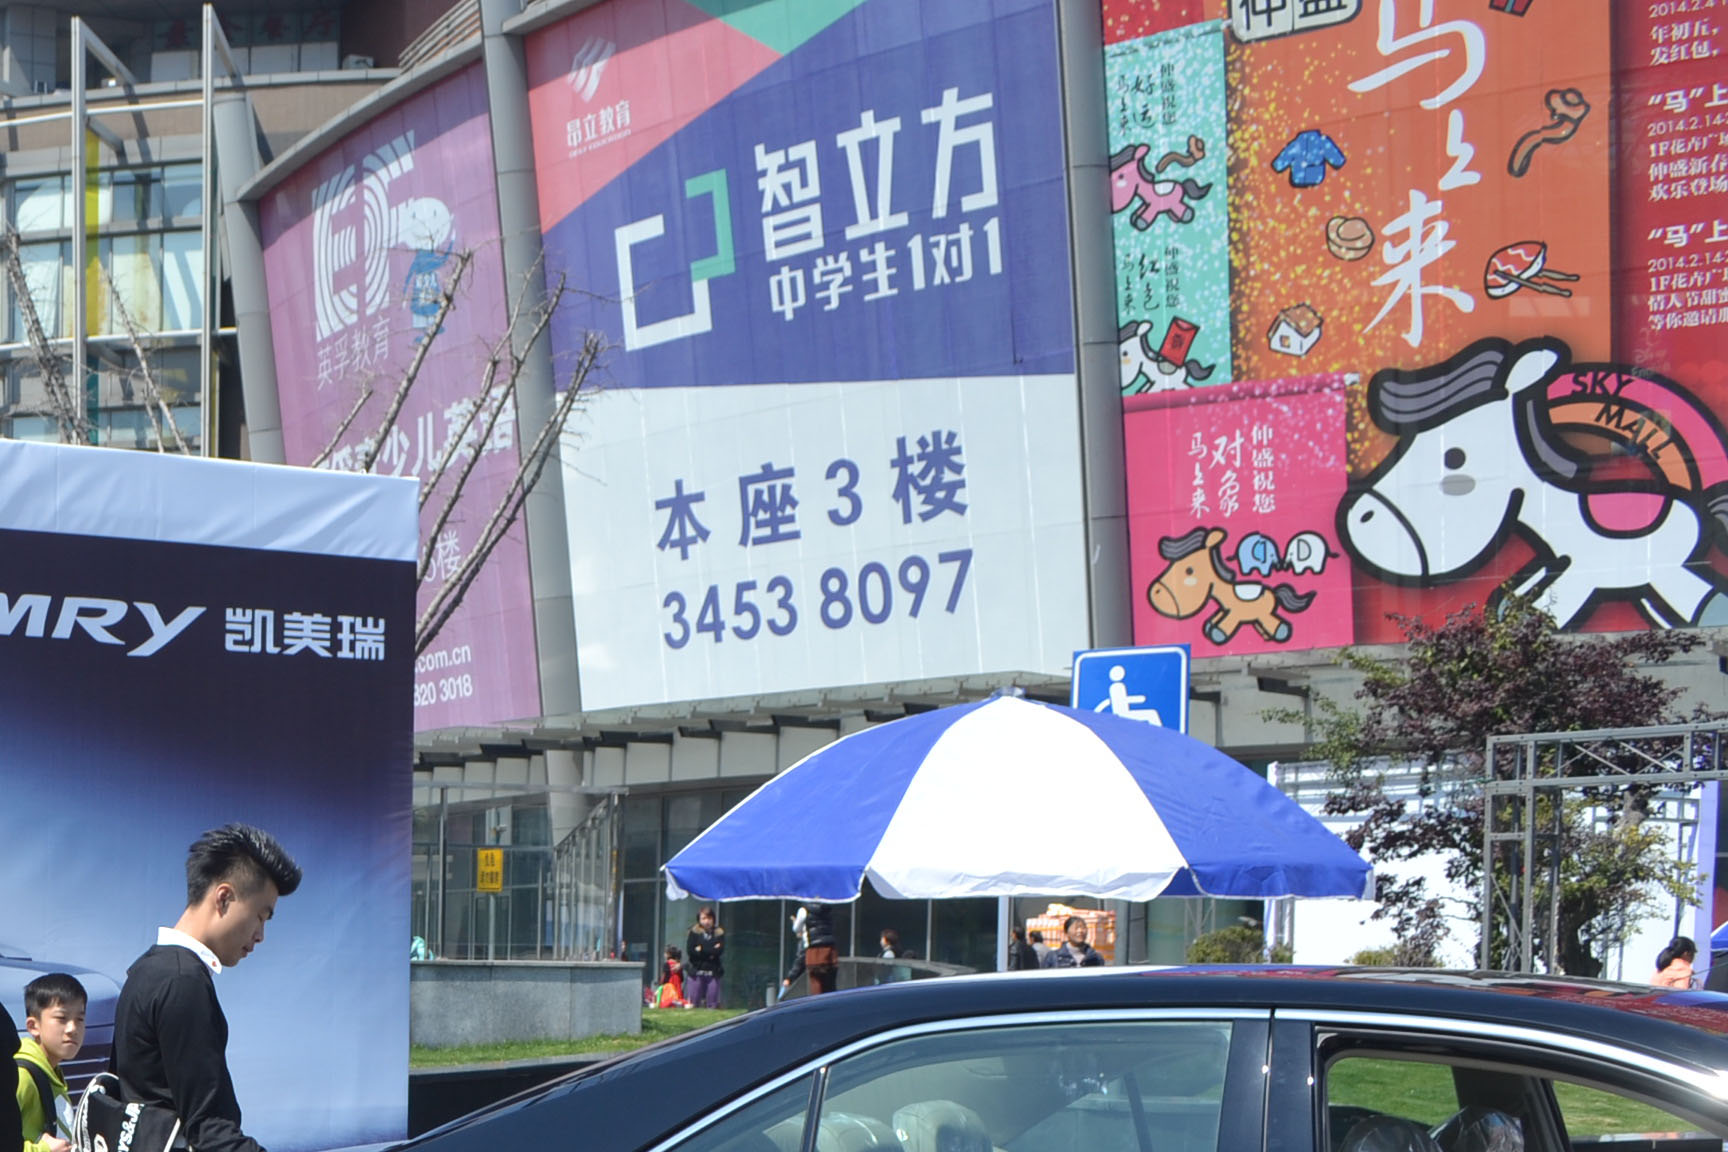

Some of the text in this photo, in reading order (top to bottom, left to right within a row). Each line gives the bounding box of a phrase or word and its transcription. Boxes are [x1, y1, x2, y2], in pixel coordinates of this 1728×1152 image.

[754, 87, 999, 262] 智立方
[769, 216, 1003, 321] 中学生1对1
[317, 315, 390, 391] 英孚教育
[1572, 371, 1635, 397] SKY
[1594, 402, 1674, 461] MALL
[1208, 428, 1245, 518] 对象
[224, 606, 385, 661] 凯美瑞
[663, 548, 973, 650] 3453 8097
[439, 674, 473, 702] 3018
